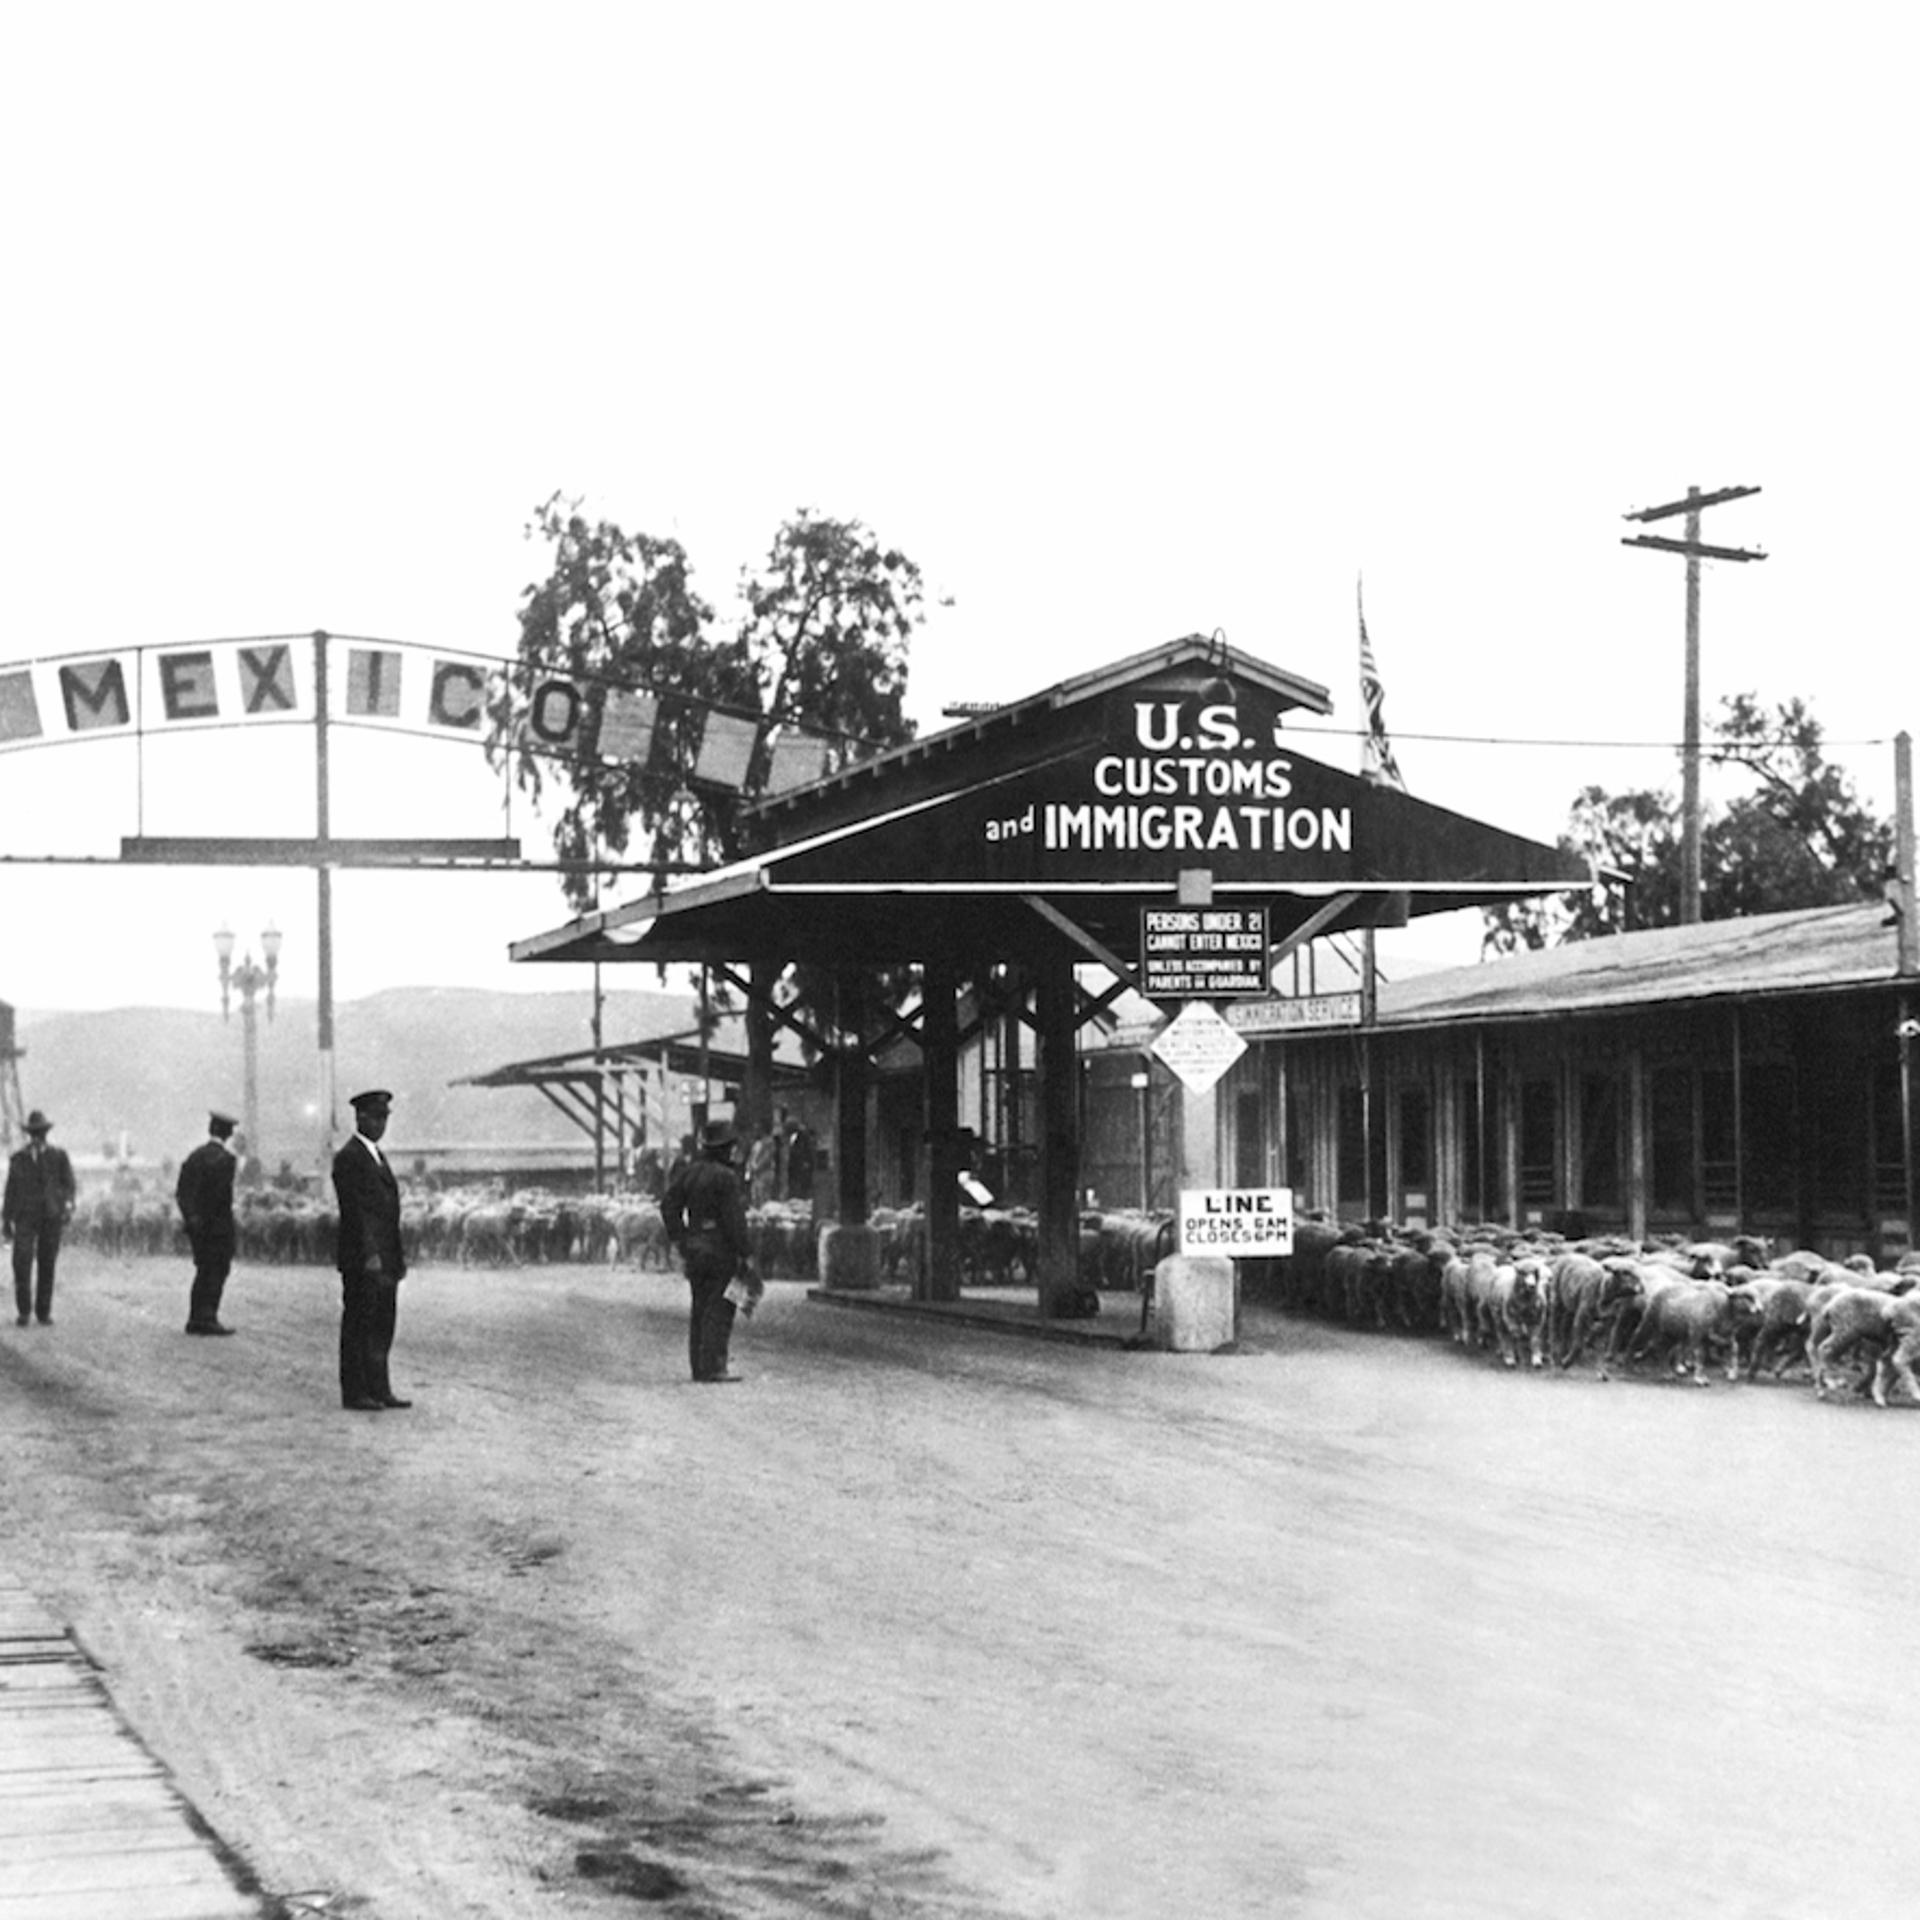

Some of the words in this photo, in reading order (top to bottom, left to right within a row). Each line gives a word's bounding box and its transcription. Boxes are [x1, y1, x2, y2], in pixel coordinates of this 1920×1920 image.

[59, 645, 580, 741] MEXICO
[1135, 703, 1255, 750] U.S.
[1095, 757, 1291, 798] CUSTOMS
[987, 805, 1033, 841] and
[1046, 805, 1350, 852] IMMIGRATION
[1146, 912, 1200, 931] PERSONS
[1203, 912, 1242, 931] UNDER
[1249, 912, 1262, 931] 21
[1190, 934, 1222, 950] ENTER
[1205, 1196, 1273, 1213] LINE
[1186, 1217, 1243, 1231] OPENS
